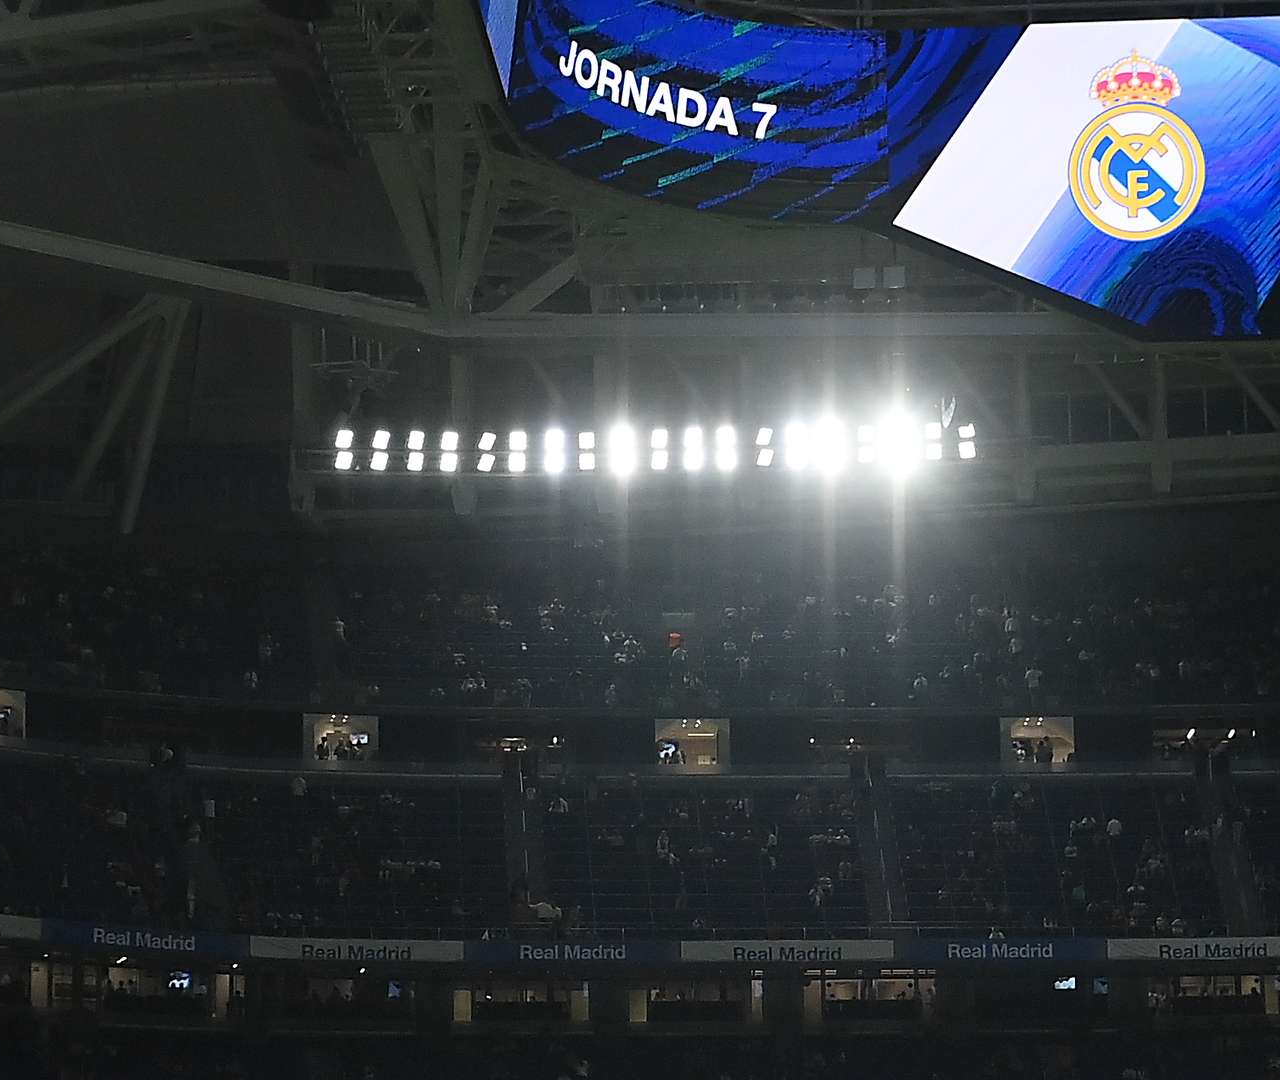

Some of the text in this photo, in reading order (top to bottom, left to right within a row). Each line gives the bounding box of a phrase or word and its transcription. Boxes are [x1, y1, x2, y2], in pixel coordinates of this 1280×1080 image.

[558, 40, 778, 140] JORNADA 7
[93, 927, 196, 951] Real Madrid
[301, 944, 411, 961] Real Madrid
[519, 944, 626, 961] Real Madrid
[733, 946, 842, 962] Real Madrid
[947, 943, 1053, 959] Real Madrid
[1159, 943, 1267, 960] Real Madrid
